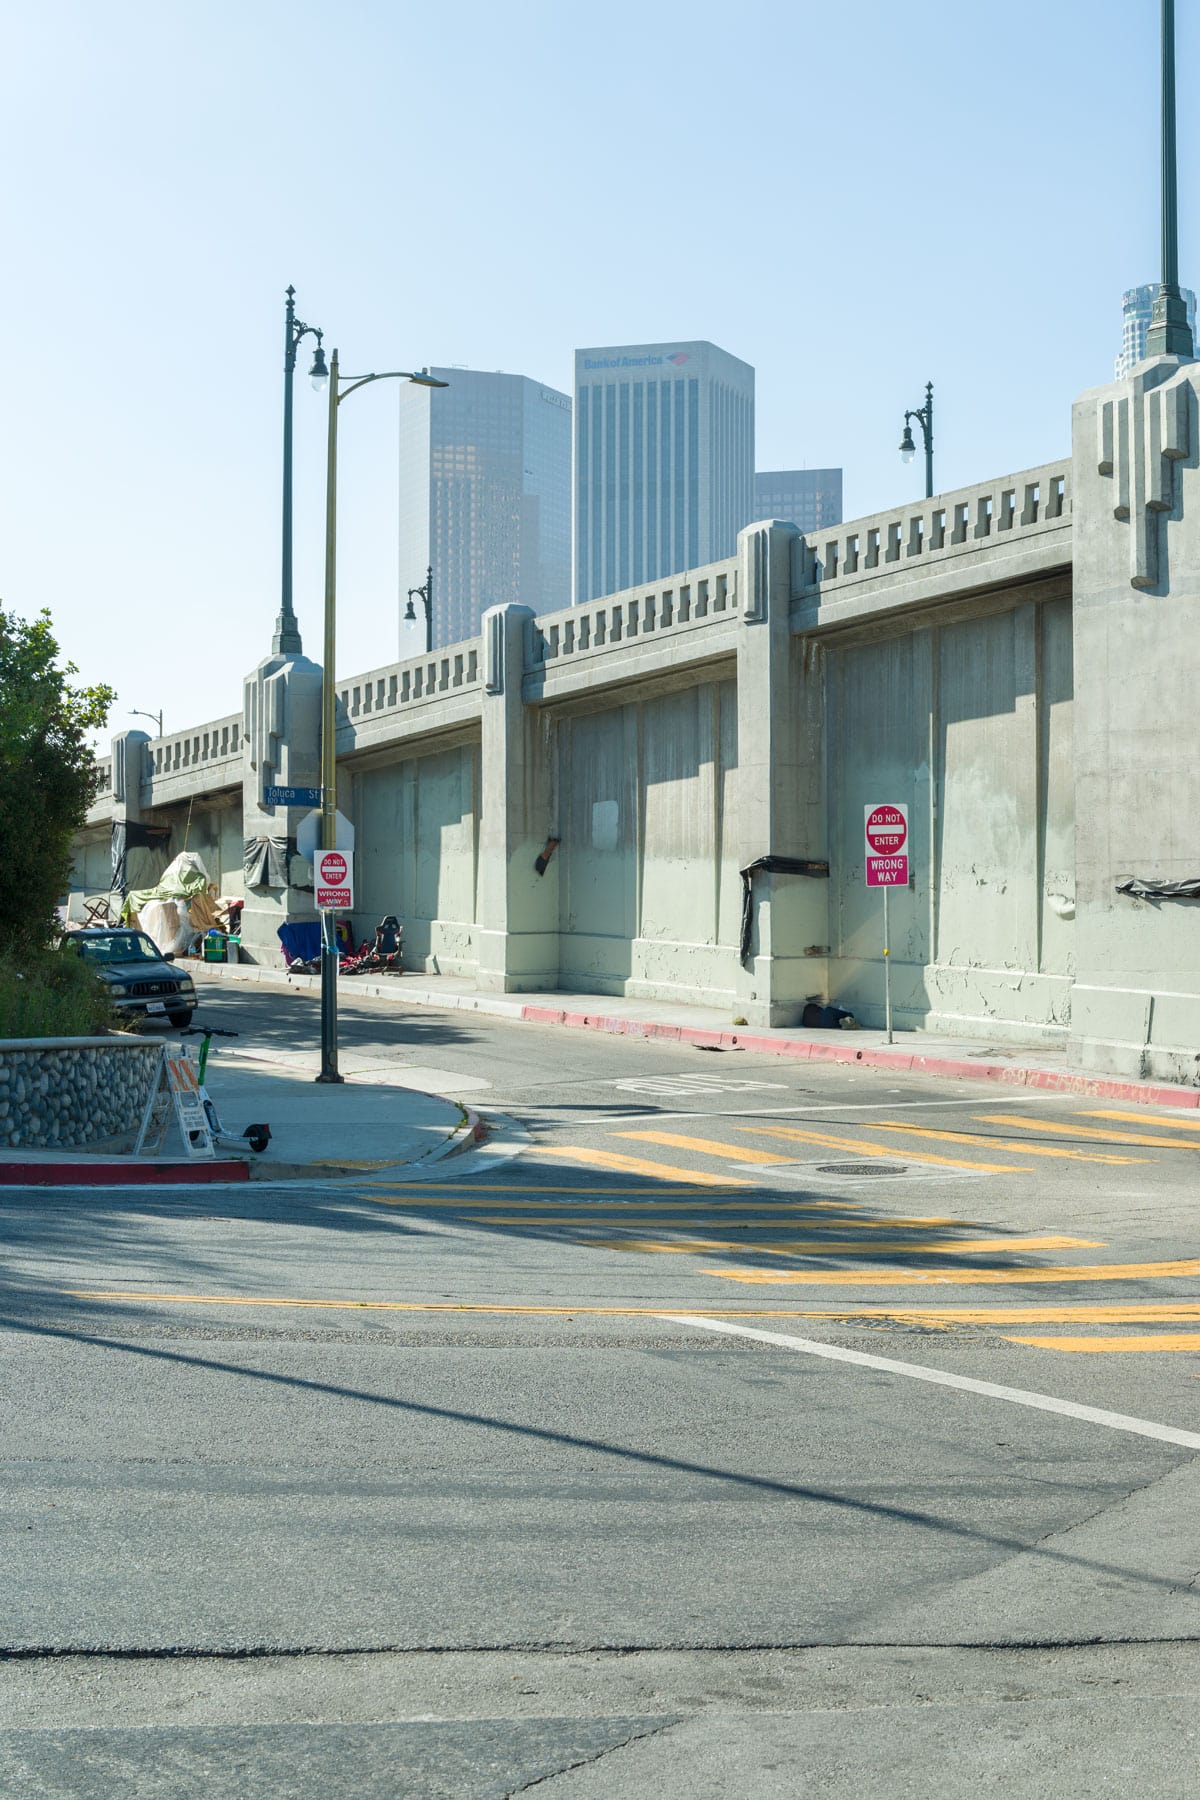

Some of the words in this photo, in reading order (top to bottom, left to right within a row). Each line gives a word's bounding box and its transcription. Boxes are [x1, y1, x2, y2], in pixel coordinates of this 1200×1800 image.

[584, 358, 609, 369] Bank
[610, 357, 622, 367] of
[623, 354, 664, 367] America
[268, 787, 295, 798] Toluca
[308, 789, 319, 799] St
[267, 796, 278, 804] 100
[872, 814, 883, 823] DO
[885, 813, 901, 823] NOT
[874, 836, 899, 846] ENTER
[871, 859, 903, 870] WRONG
[877, 871, 898, 882] WAY
